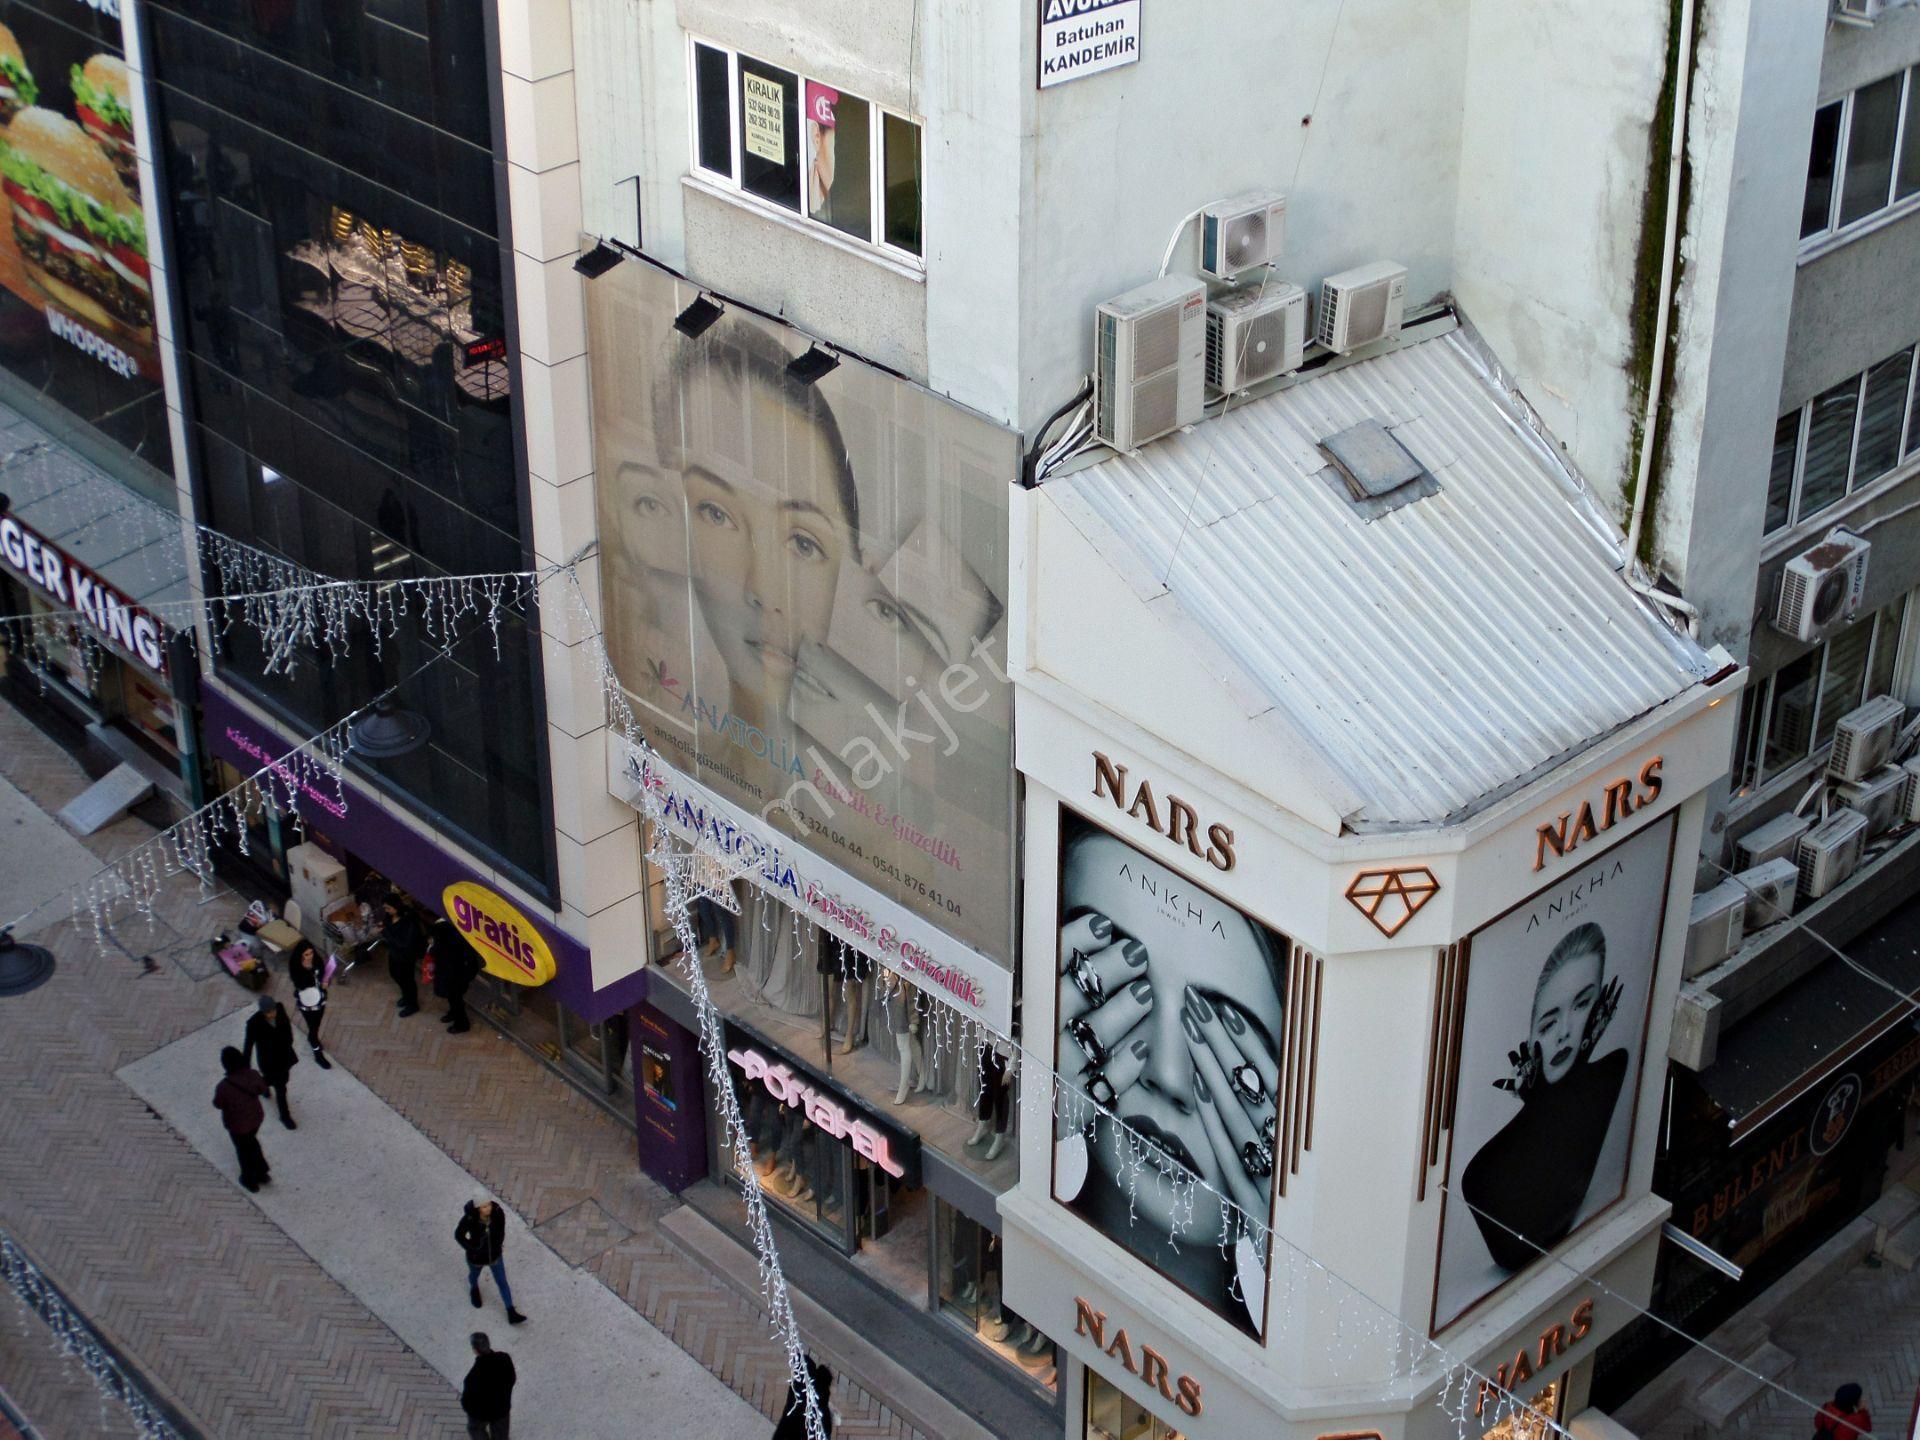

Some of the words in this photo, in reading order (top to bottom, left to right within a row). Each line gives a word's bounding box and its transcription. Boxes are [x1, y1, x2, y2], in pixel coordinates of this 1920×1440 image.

[1044, 35, 1136, 75] KANDEMİR
[1056, 18, 1124, 47] Batuhan
[0, 518, 67, 602] GER
[70, 567, 162, 669] KING
[1091, 750, 1236, 872] NARS
[1532, 756, 1664, 873] NARS
[453, 895, 536, 970] gratis
[831, 831, 847, 848] 04
[848, 842, 864, 859] 44
[872, 855, 901, 882] 0541
[903, 874, 927, 896] 876
[928, 889, 944, 907] 41
[946, 898, 962, 917] 04
[1073, 1296, 1203, 1417] NARS
[1474, 1299, 1594, 1417] NARS
